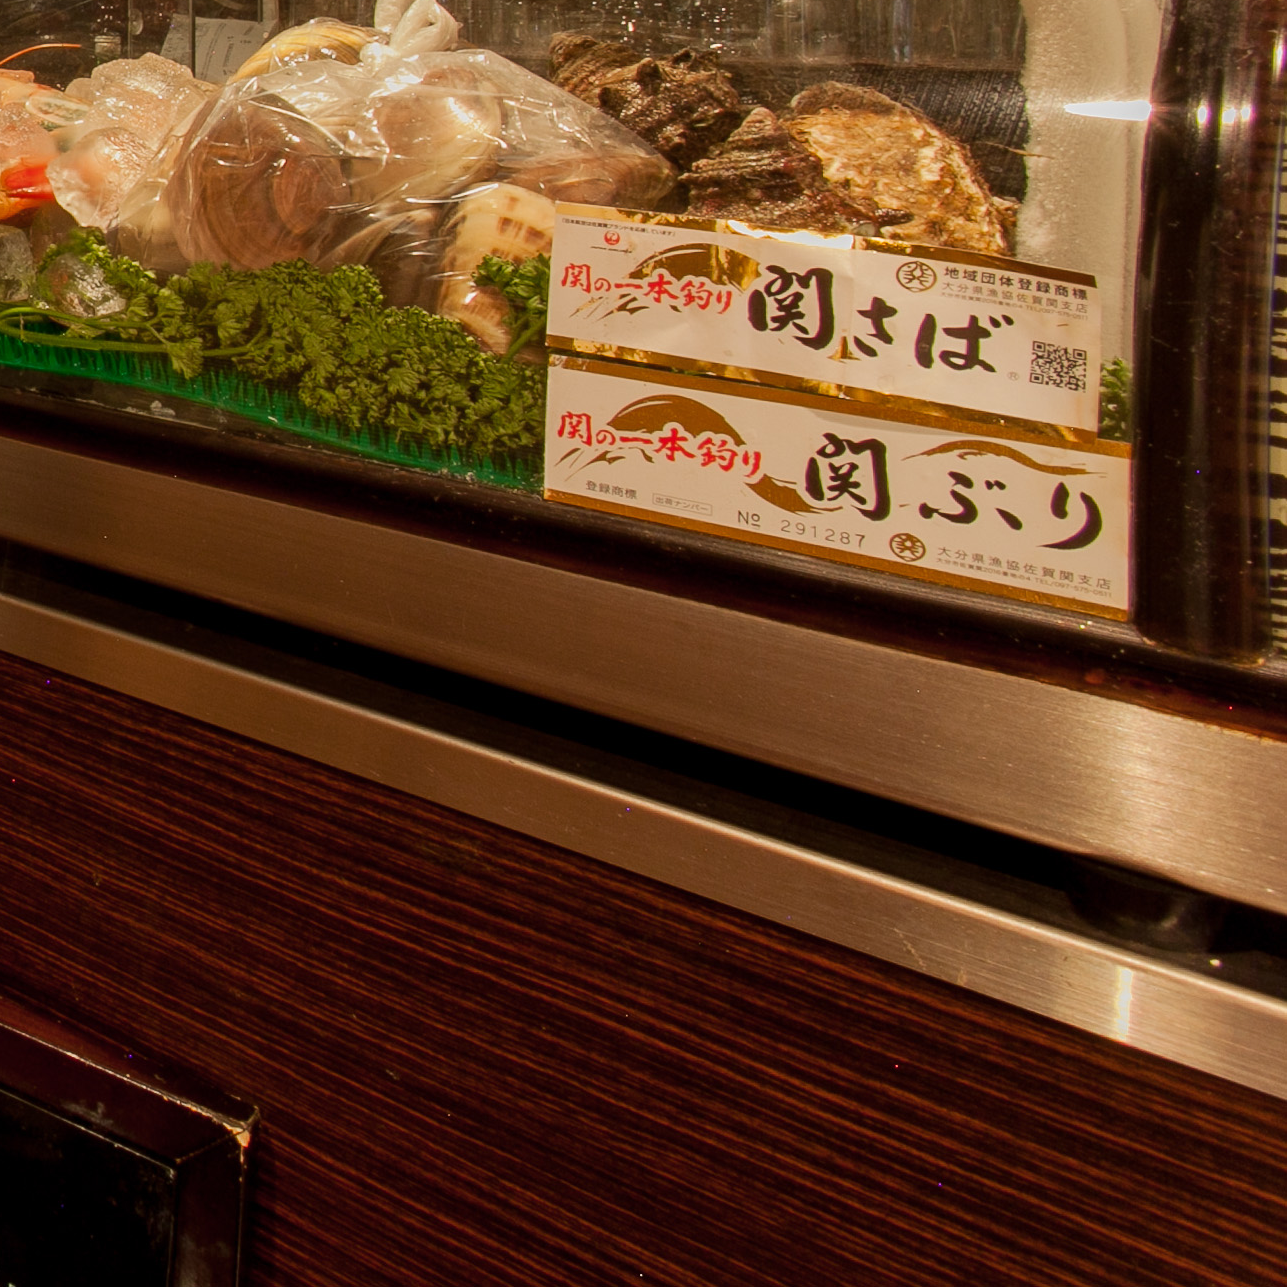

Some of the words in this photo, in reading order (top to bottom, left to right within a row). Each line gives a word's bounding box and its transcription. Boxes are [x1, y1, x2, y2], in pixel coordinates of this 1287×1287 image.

[561, 263, 733, 314] 関の一本釣り
[941, 281, 1088, 314] 大分県漁協佐賀関支店
[943, 266, 1088, 302] 地域団体登録商標
[748, 264, 1015, 374] 関さば
[557, 411, 762, 478] 関の一本釣り
[585, 479, 638, 501] 登録商標
[655, 495, 709, 513] 出荷ナンバー
[804, 432, 1104, 551] 関ぶり
[780, 519, 866, 549] 291287
[937, 546, 1113, 591] 大分県漁協佐賀関支店
